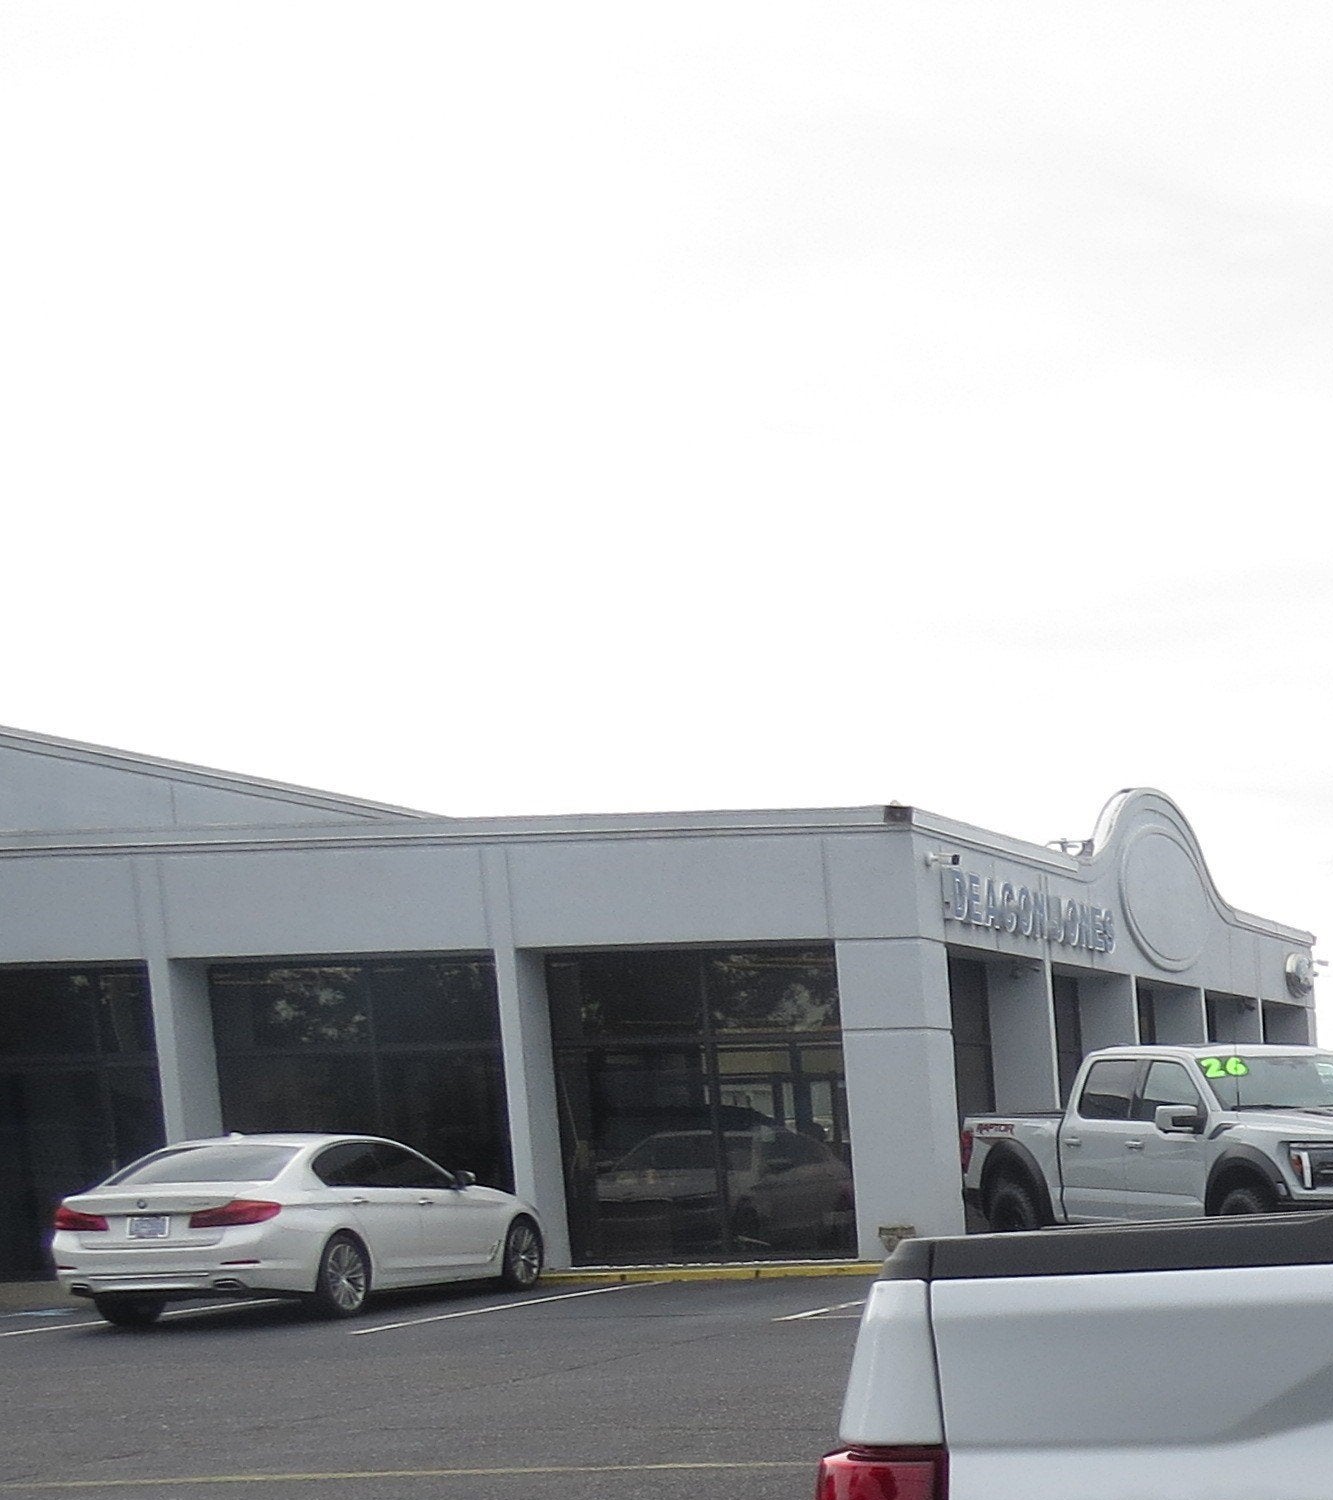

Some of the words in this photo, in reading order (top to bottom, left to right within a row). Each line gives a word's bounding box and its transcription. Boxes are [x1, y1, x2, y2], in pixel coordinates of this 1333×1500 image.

[951, 867, 1049, 940] DEACON
[1051, 896, 1116, 954] JONES
[1200, 1056, 1249, 1079] 26
